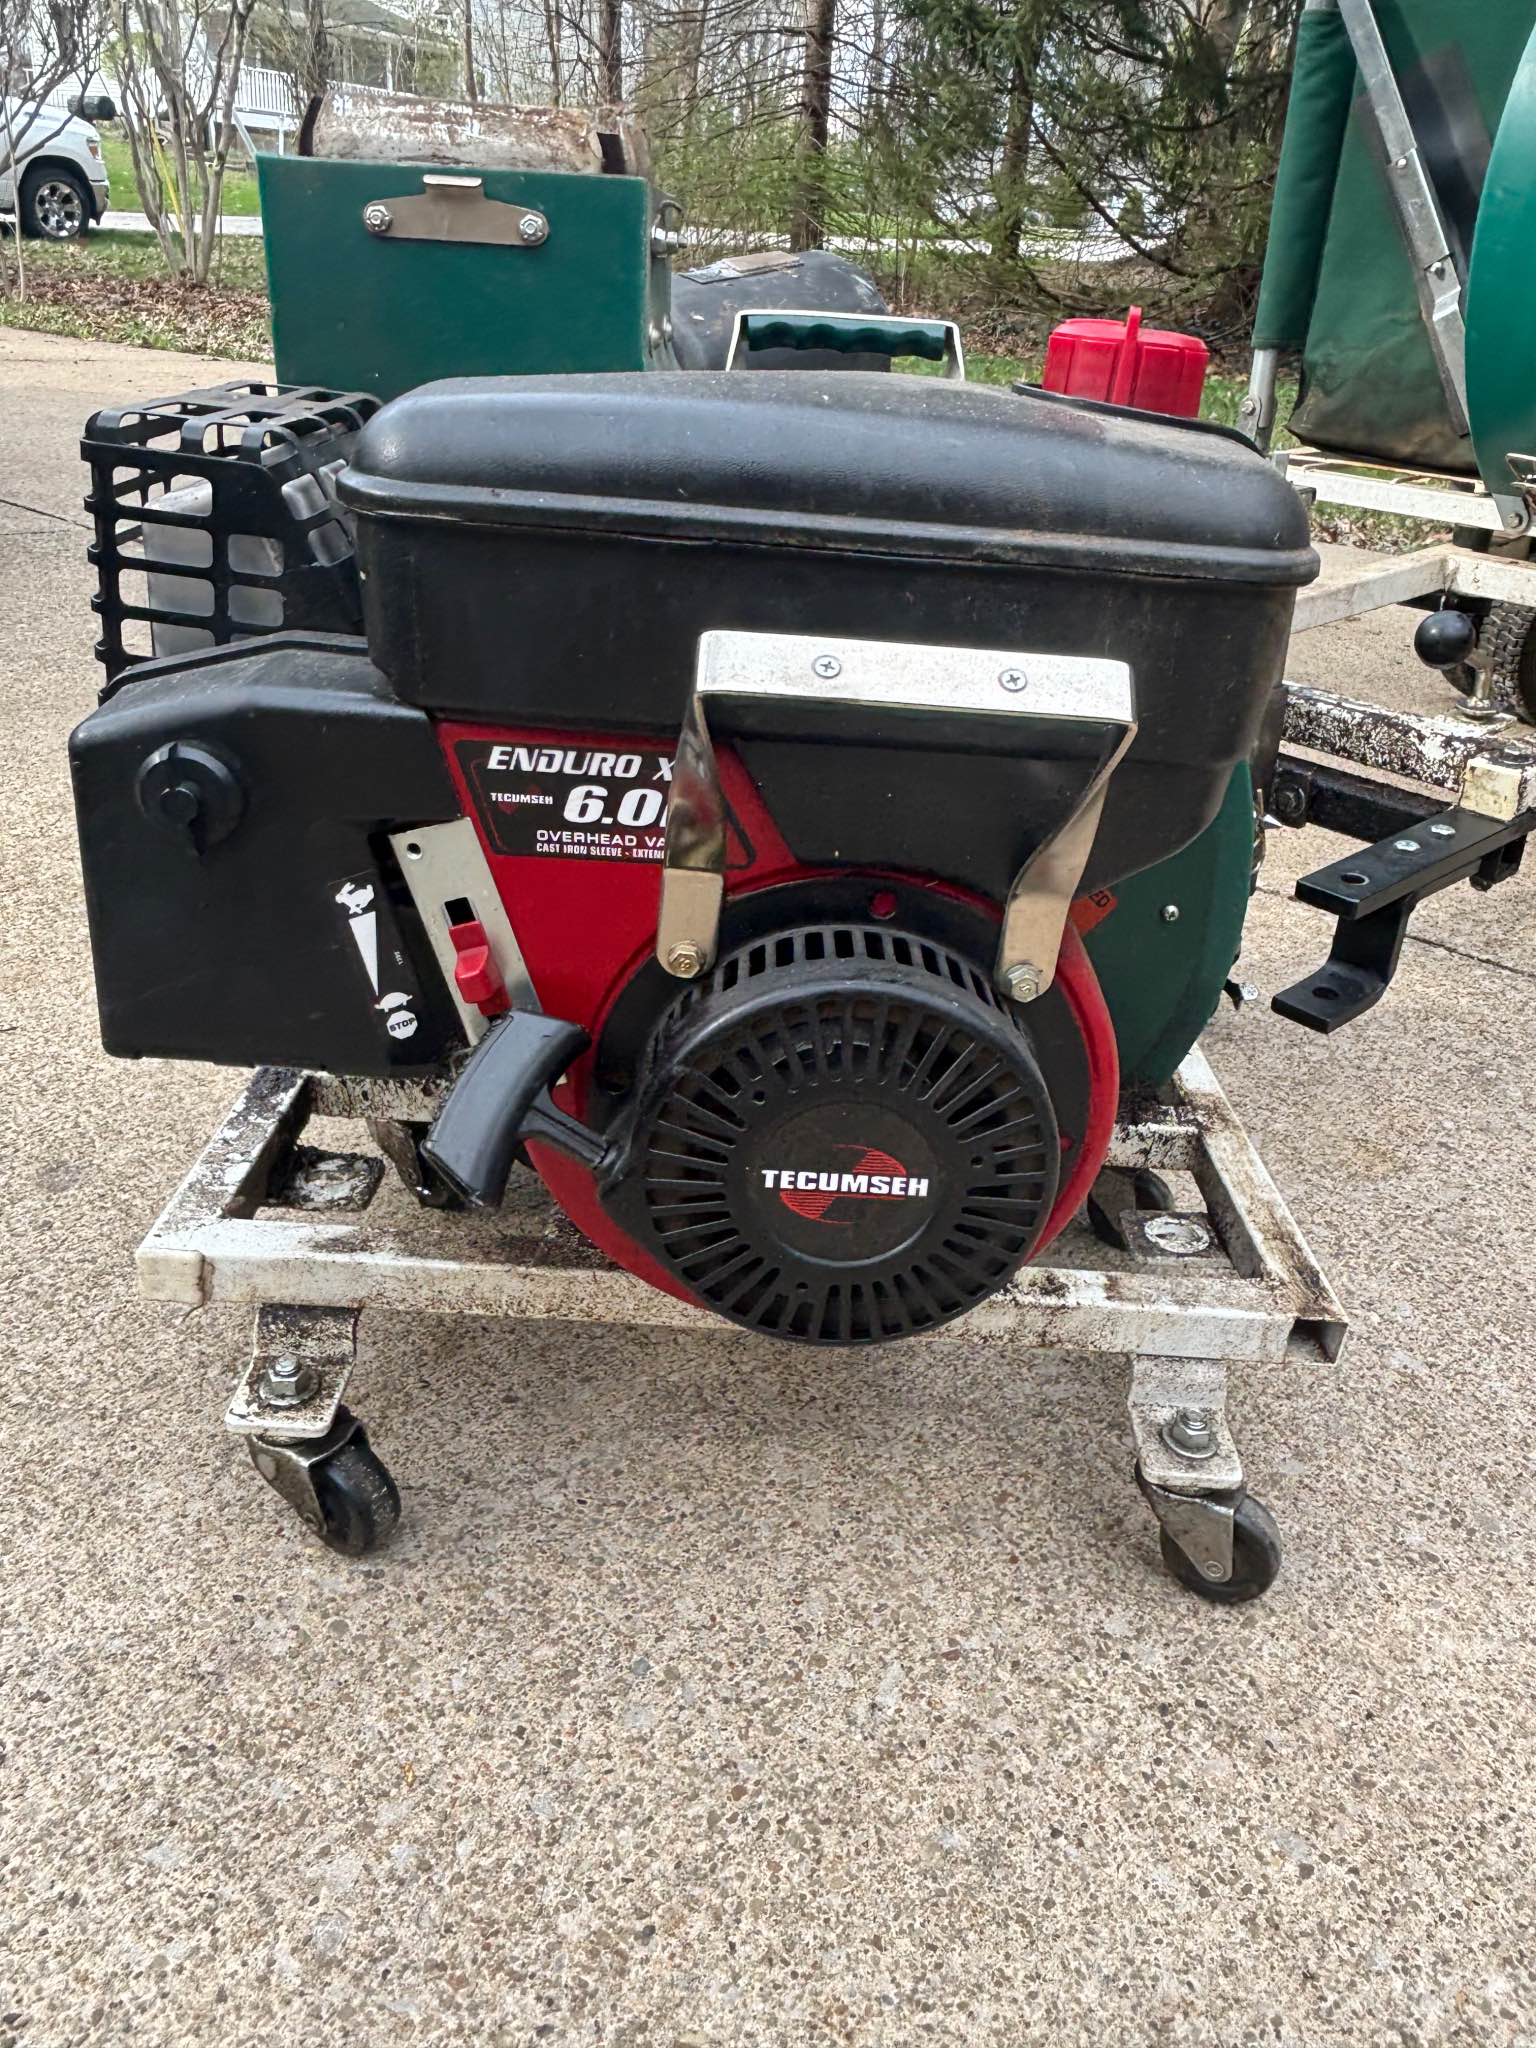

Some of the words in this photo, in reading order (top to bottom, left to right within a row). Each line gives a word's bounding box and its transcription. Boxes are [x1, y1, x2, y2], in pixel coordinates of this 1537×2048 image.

[487, 745, 643, 778] ENDURO
[490, 792, 554, 805] TECUMSEH
[563, 785, 668, 828] 6.0
[536, 829, 638, 847] OVERHEAD
[536, 842, 561, 853] CAST
[563, 844, 588, 855] IRON
[590, 846, 623, 857] SLEEVE
[389, 1017, 417, 1033] STOP
[761, 1169, 929, 1197] TECUMSEH
